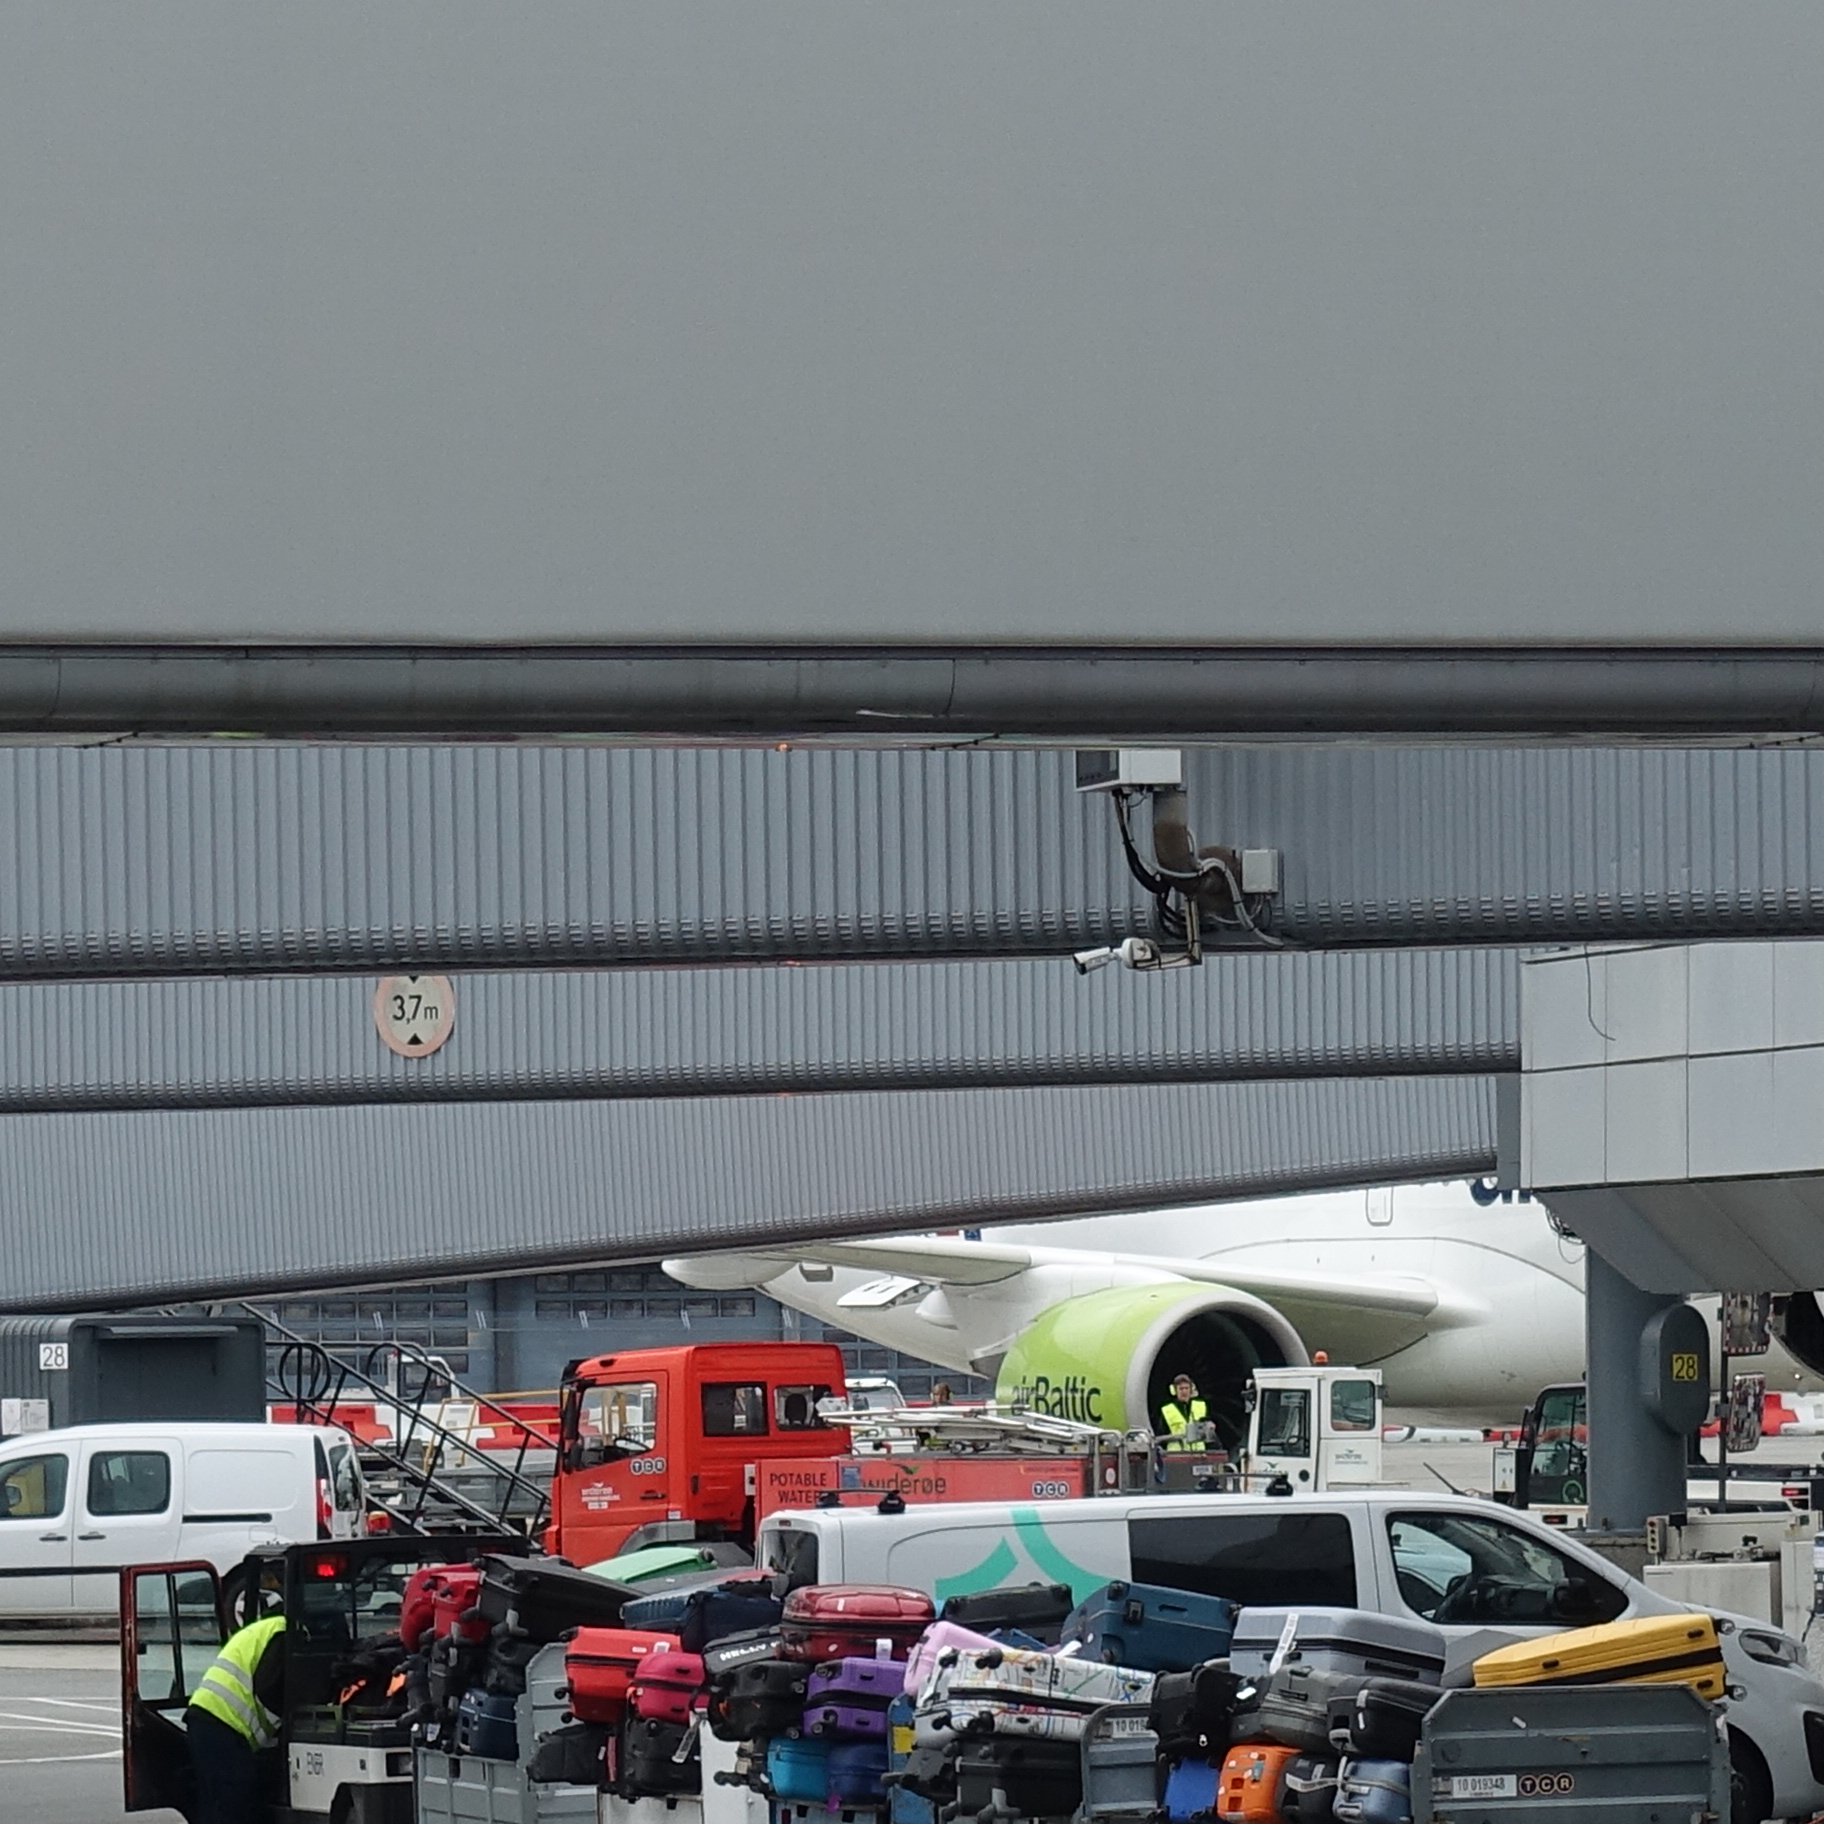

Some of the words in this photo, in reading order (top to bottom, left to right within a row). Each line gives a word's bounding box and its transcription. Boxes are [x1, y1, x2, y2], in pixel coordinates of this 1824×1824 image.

[43, 1347, 65, 1367] 28
[1675, 1356, 1696, 1379] 28
[1011, 1376, 1103, 1423] airBaltic
[770, 1473, 826, 1486] POTABLE
[1457, 1779, 1468, 1791] 10
[1520, 1775, 1573, 1794] TCR
